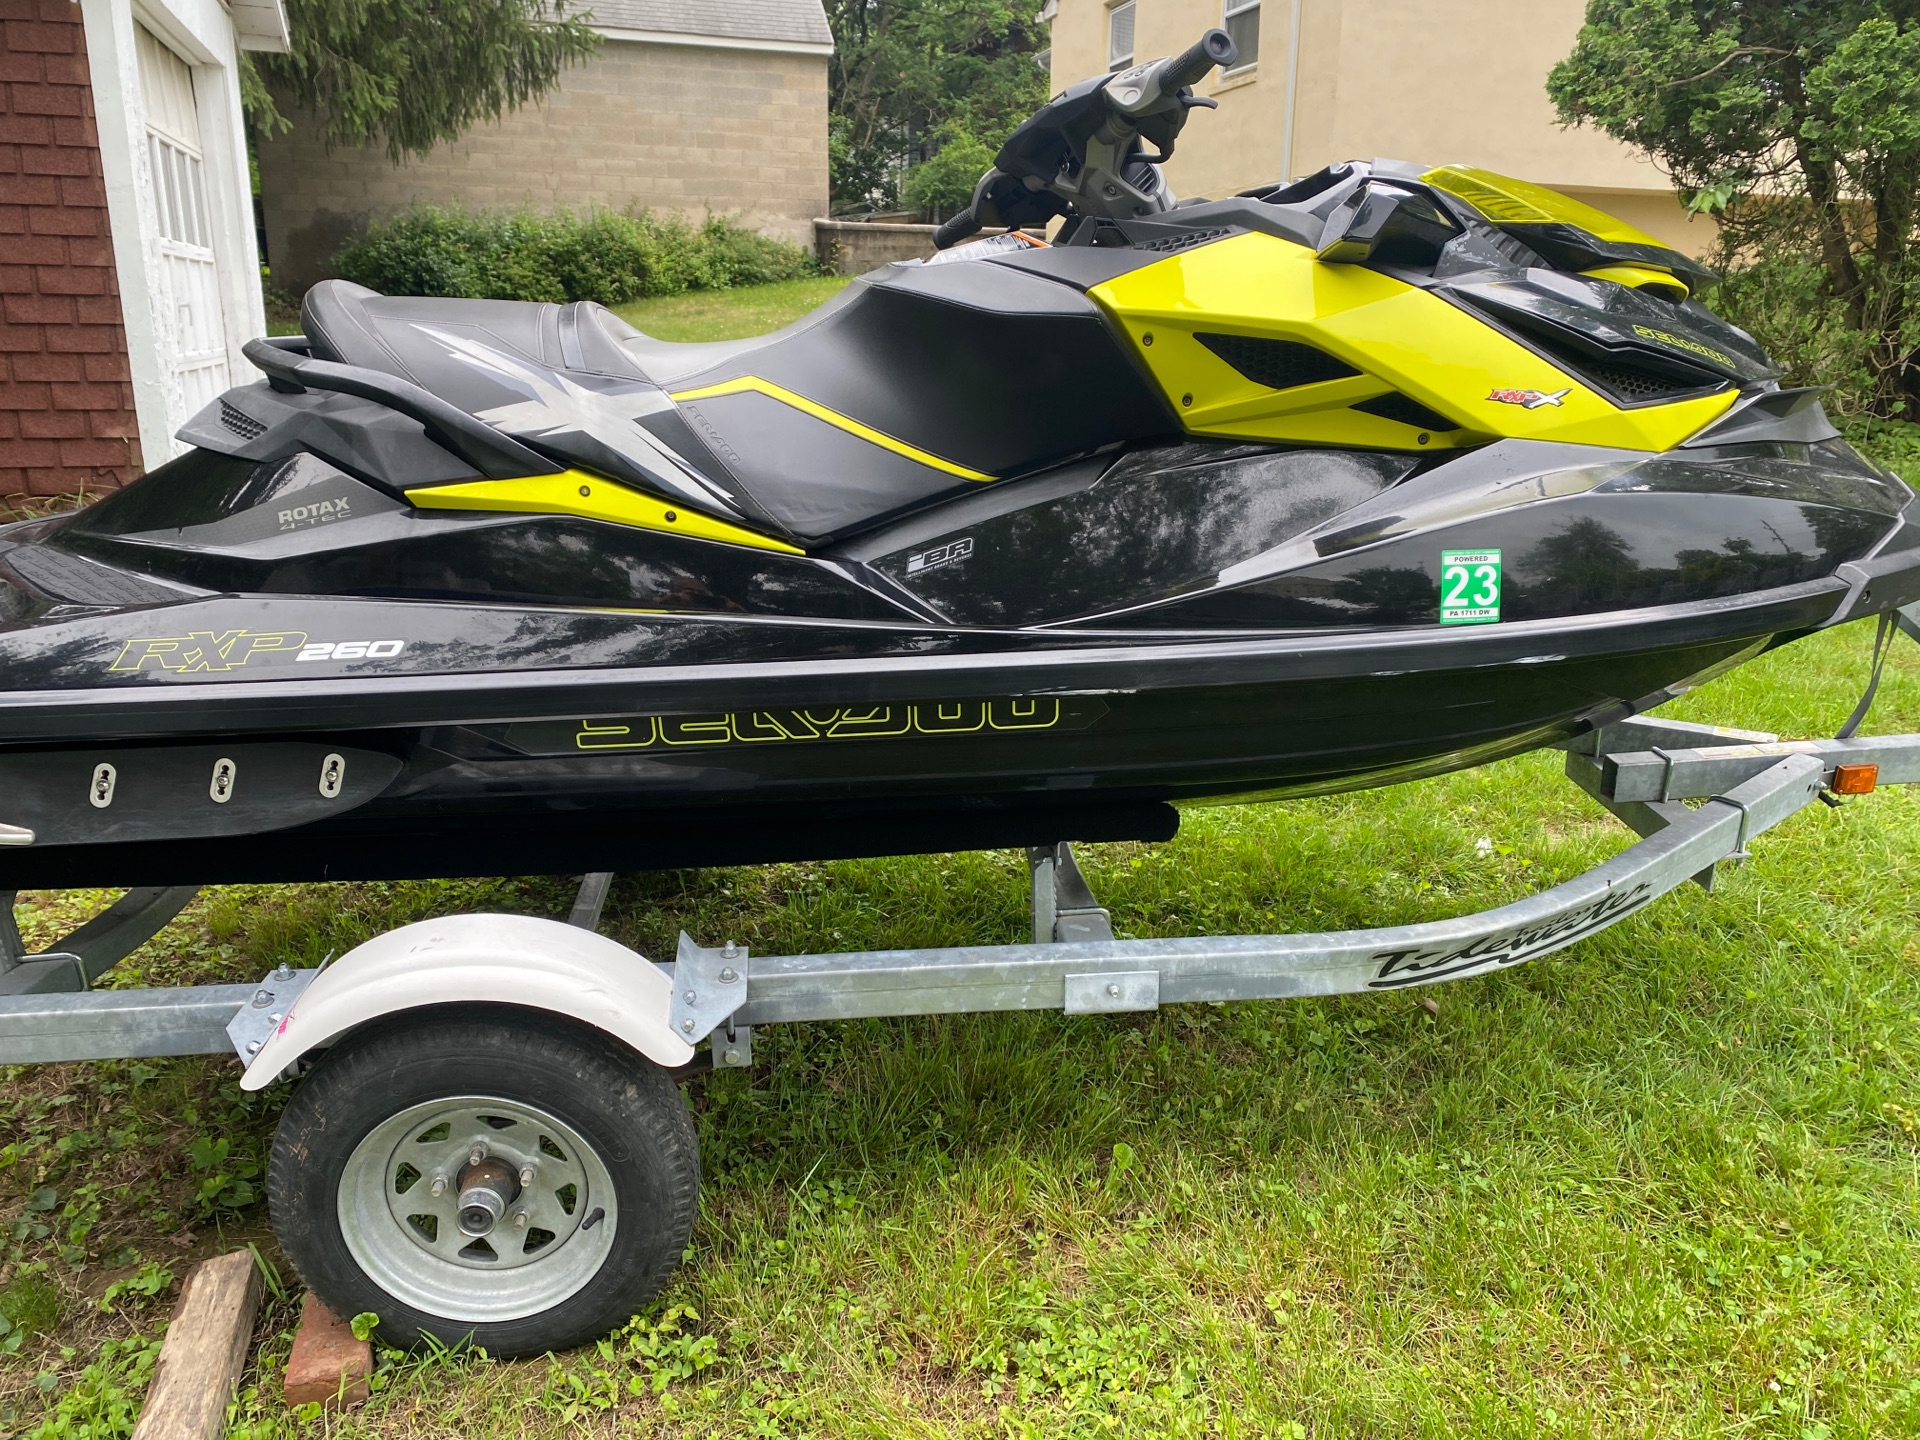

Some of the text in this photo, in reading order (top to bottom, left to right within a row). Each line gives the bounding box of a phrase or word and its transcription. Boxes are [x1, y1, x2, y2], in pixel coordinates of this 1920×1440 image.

[278, 496, 350, 524] ROTAX
[279, 509, 352, 531] 4-TEC
[1454, 555, 1489, 563] POWERED
[1443, 564, 1499, 607] 23
[108, 629, 405, 672] RXP 260
